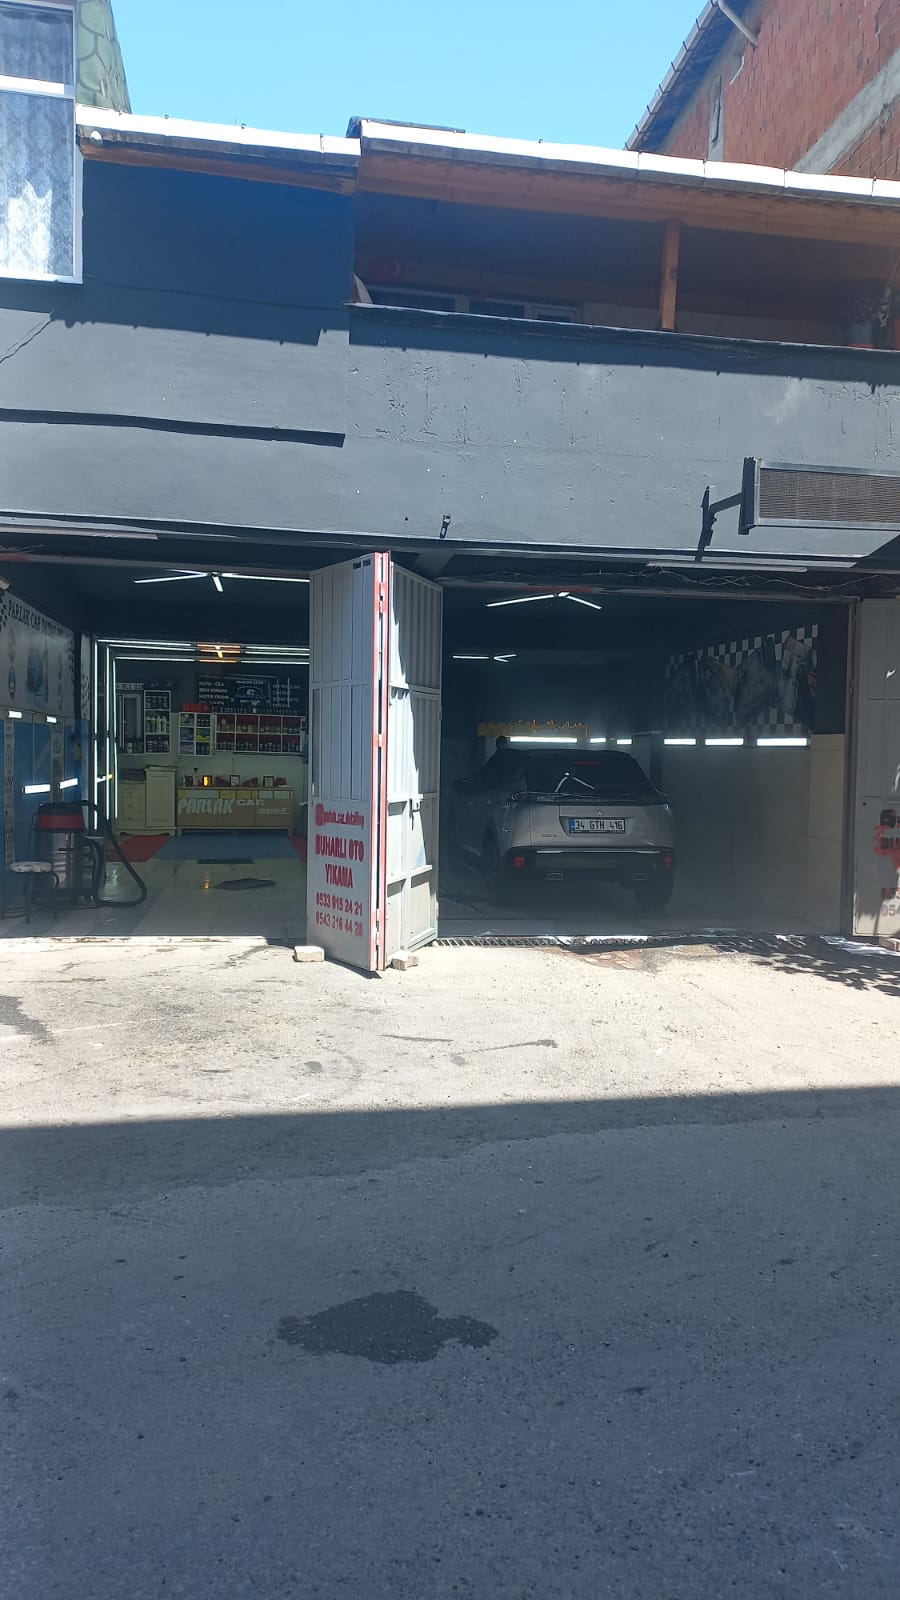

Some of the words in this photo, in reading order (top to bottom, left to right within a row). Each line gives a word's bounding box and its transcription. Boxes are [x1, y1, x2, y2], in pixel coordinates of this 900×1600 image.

[177, 798, 234, 815] PARLAK
[575, 820, 585, 830] 34
[589, 820, 605, 830] GTH
[315, 834, 347, 859] BUHARLI
[349, 839, 365, 862] OTO
[325, 863, 353, 888] YIKAMA
[316, 892, 331, 908] 0533
[345, 898, 353, 914] 24
[354, 901, 363, 917] 21
[316, 911, 331, 927] 0543
[345, 918, 353, 935] 44
